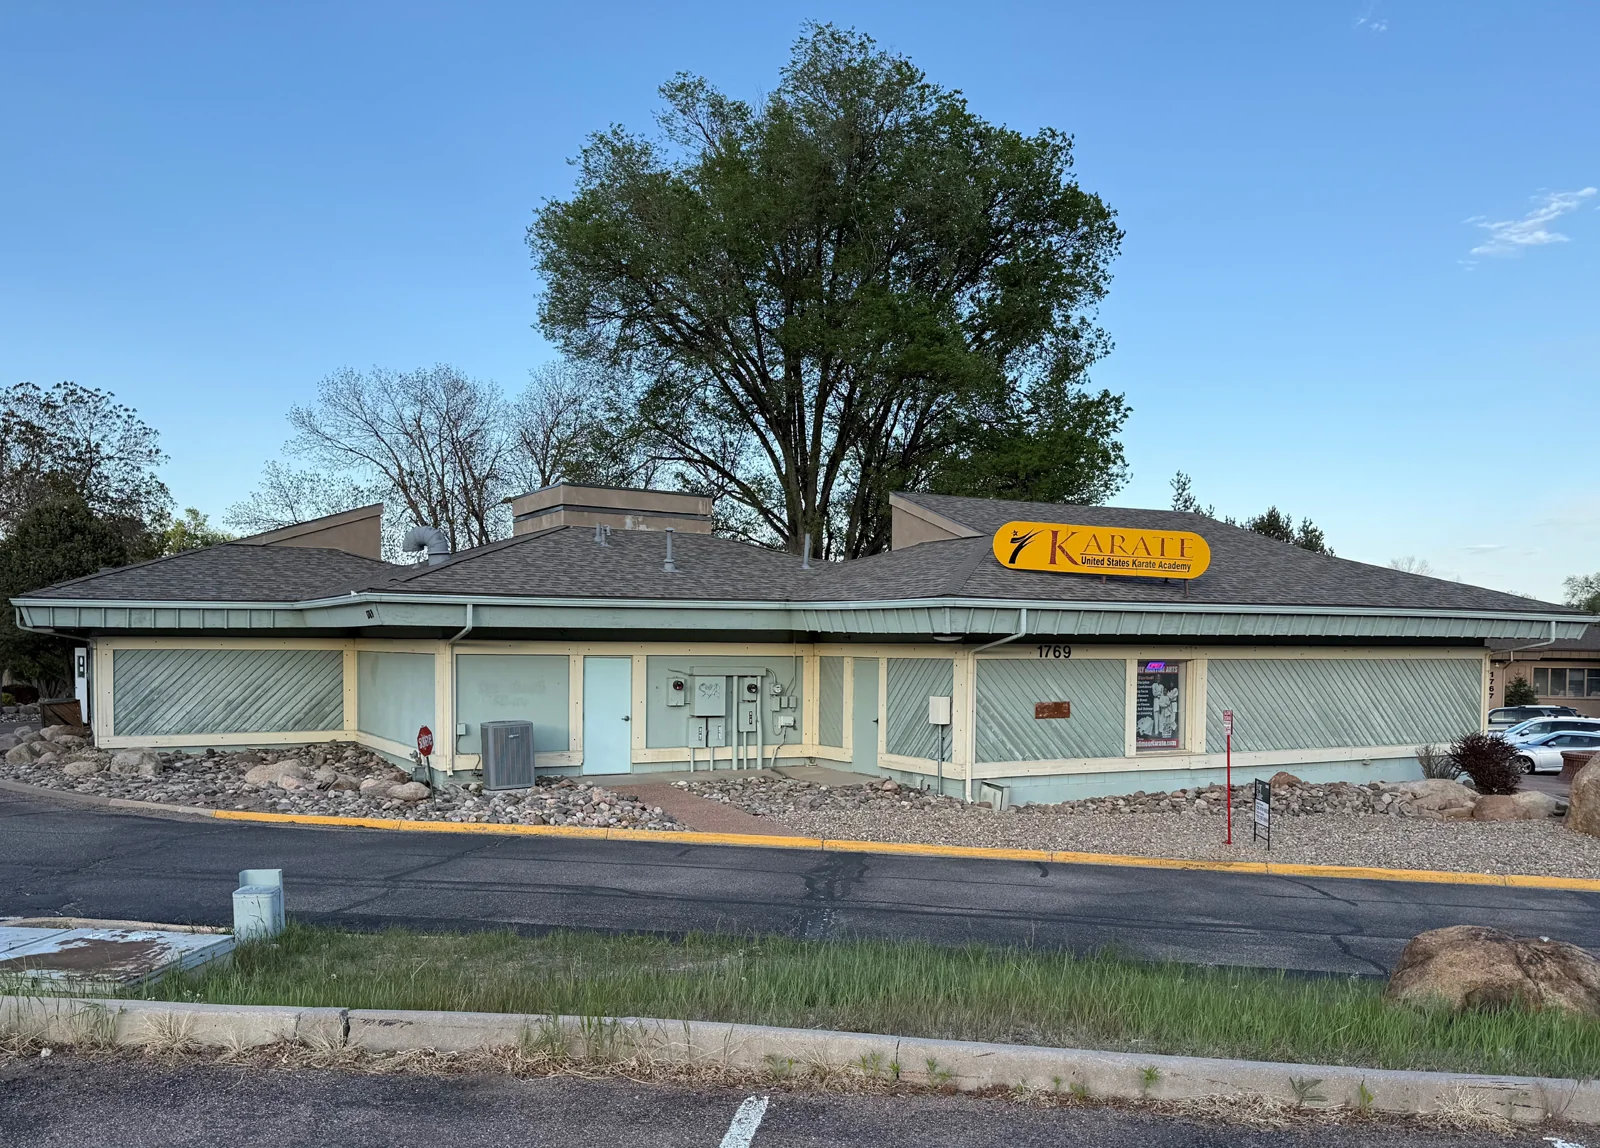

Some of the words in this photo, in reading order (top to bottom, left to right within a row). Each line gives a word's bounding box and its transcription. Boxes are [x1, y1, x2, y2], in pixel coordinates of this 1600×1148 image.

[1048, 529, 1194, 566] KARATE
[1081, 555, 1105, 567] United
[1106, 557, 1130, 568] States
[1131, 558, 1156, 570] Karate
[1158, 560, 1191, 573] Academy
[1037, 645, 1072, 659] 1769
